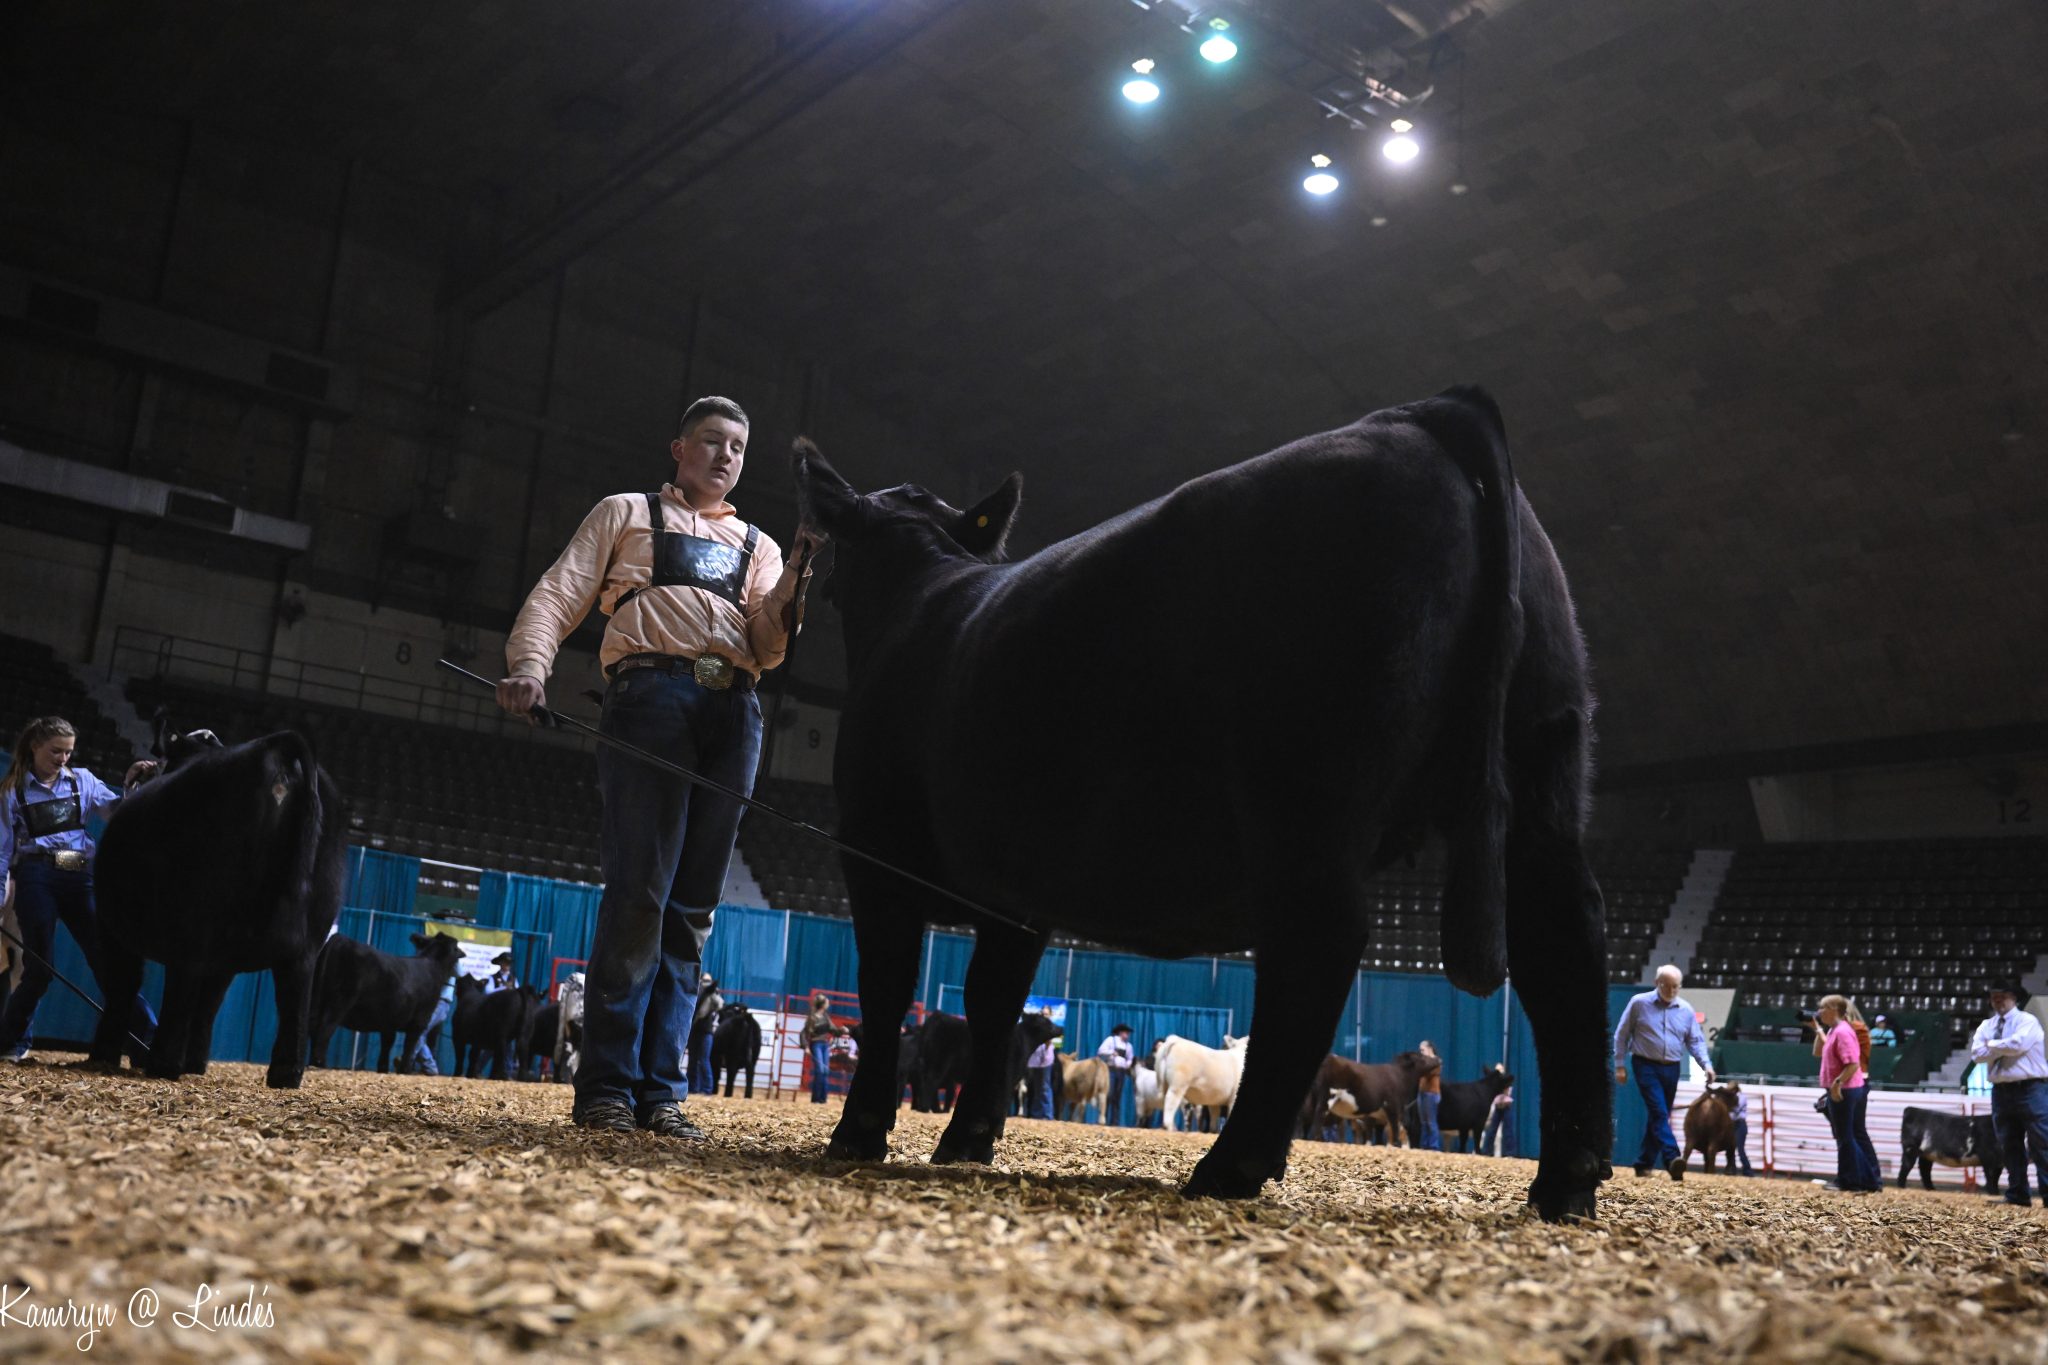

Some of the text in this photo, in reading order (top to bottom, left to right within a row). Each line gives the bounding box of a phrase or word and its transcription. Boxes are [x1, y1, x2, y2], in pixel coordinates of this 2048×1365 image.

[395, 641, 412, 666] 8
[808, 728, 821, 750] 9
[1997, 798, 2032, 825] 12
